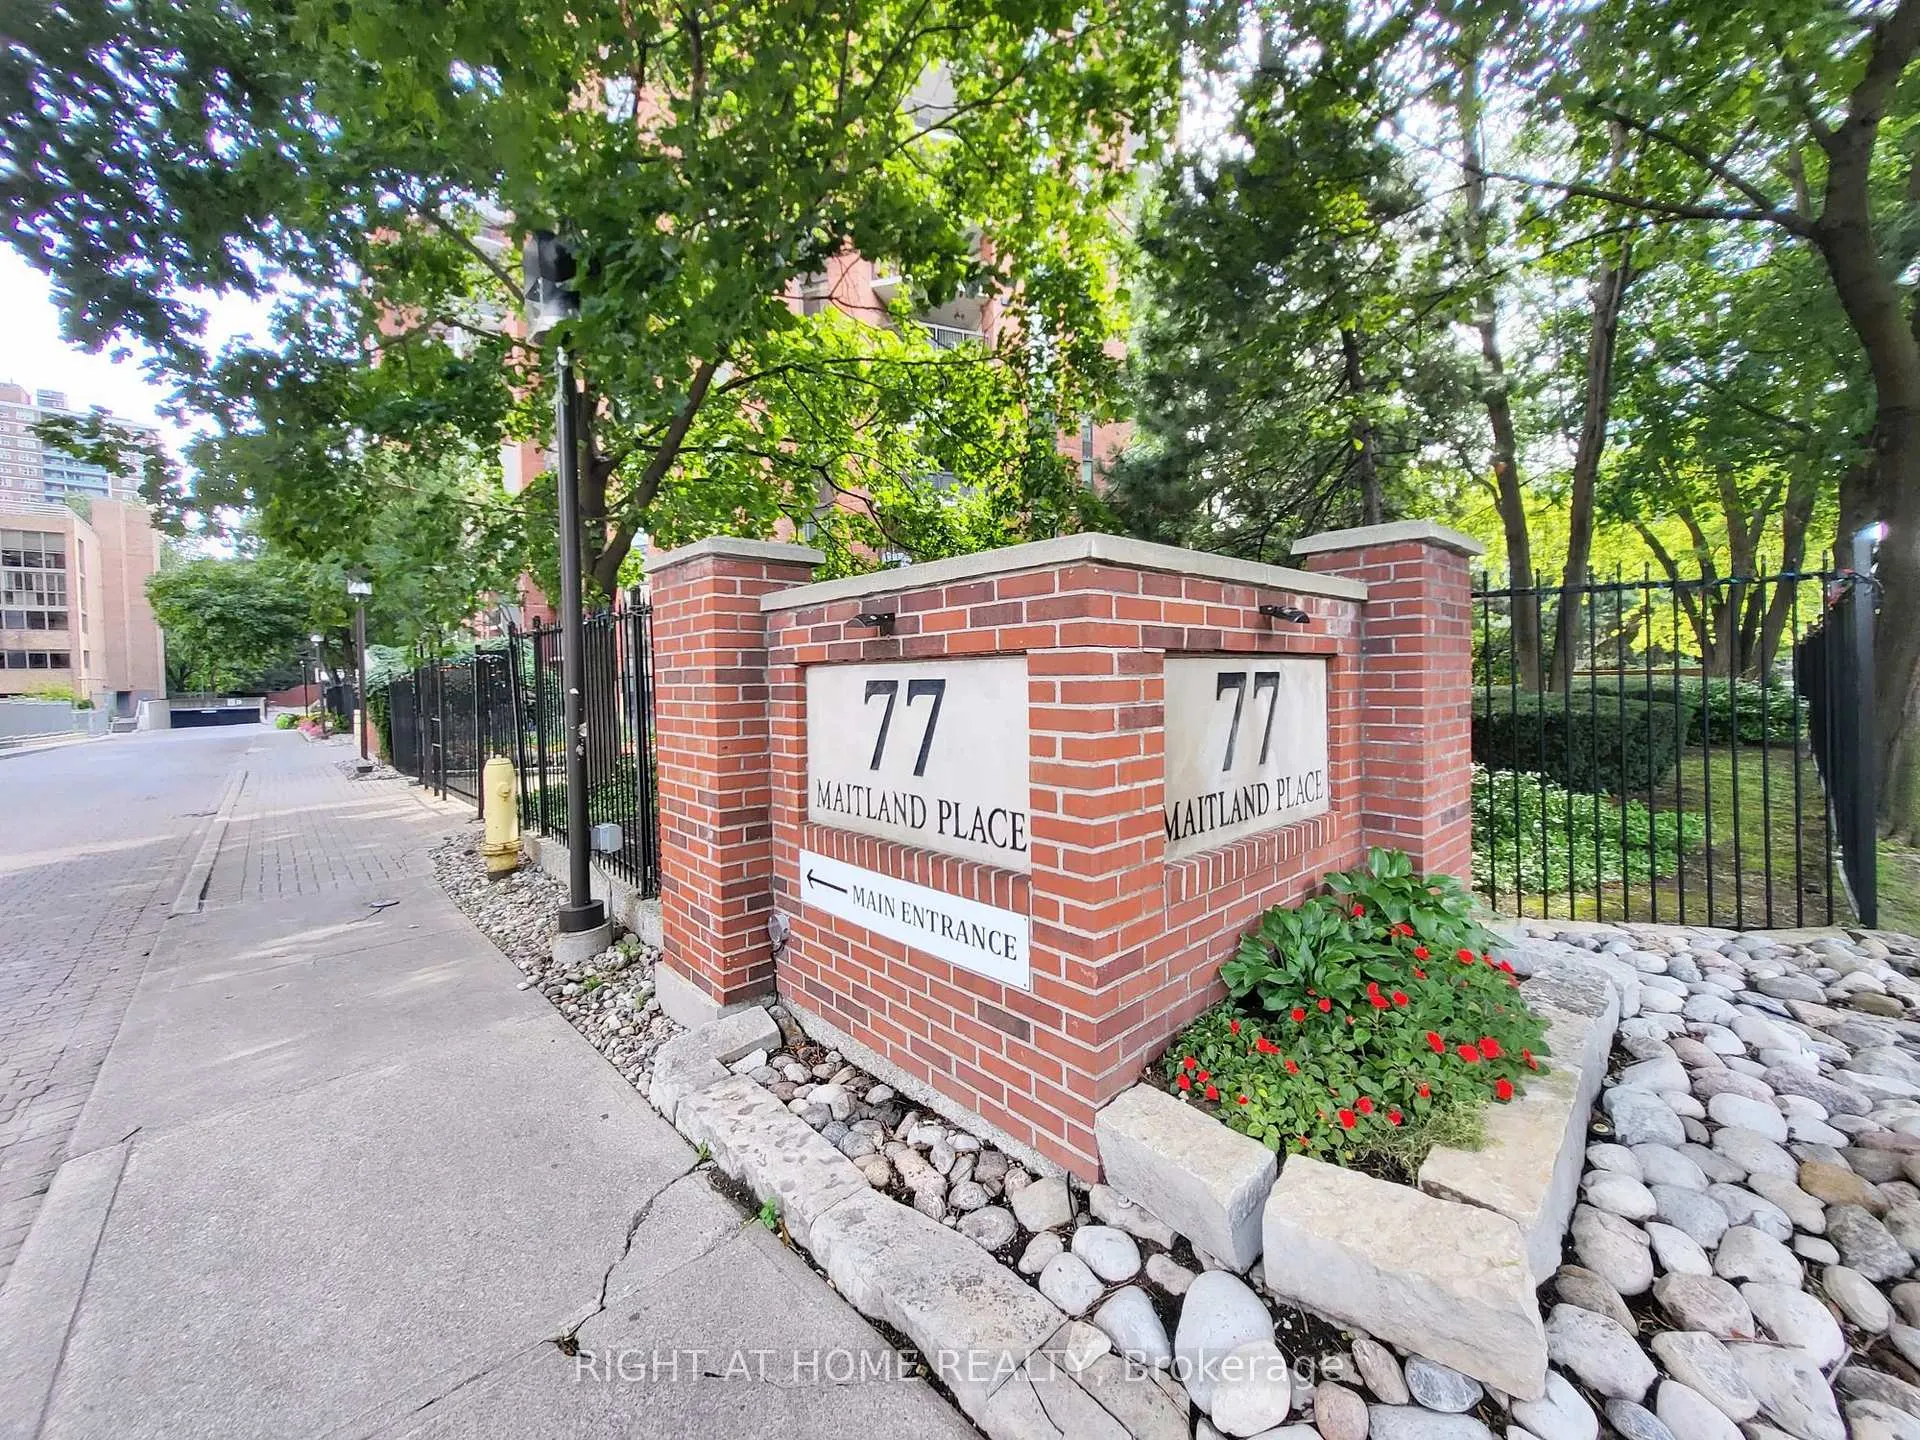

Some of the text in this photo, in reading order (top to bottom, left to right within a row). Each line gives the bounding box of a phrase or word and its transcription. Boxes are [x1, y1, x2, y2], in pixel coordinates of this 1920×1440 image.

[864, 678, 946, 776] 77
[1216, 671, 1280, 772] 77
[816, 778, 1028, 852] MAITLAND PLACE
[1163, 770, 1323, 842] MAITLAND PLACE
[853, 885, 1017, 961] MAIN ENTRANCE
